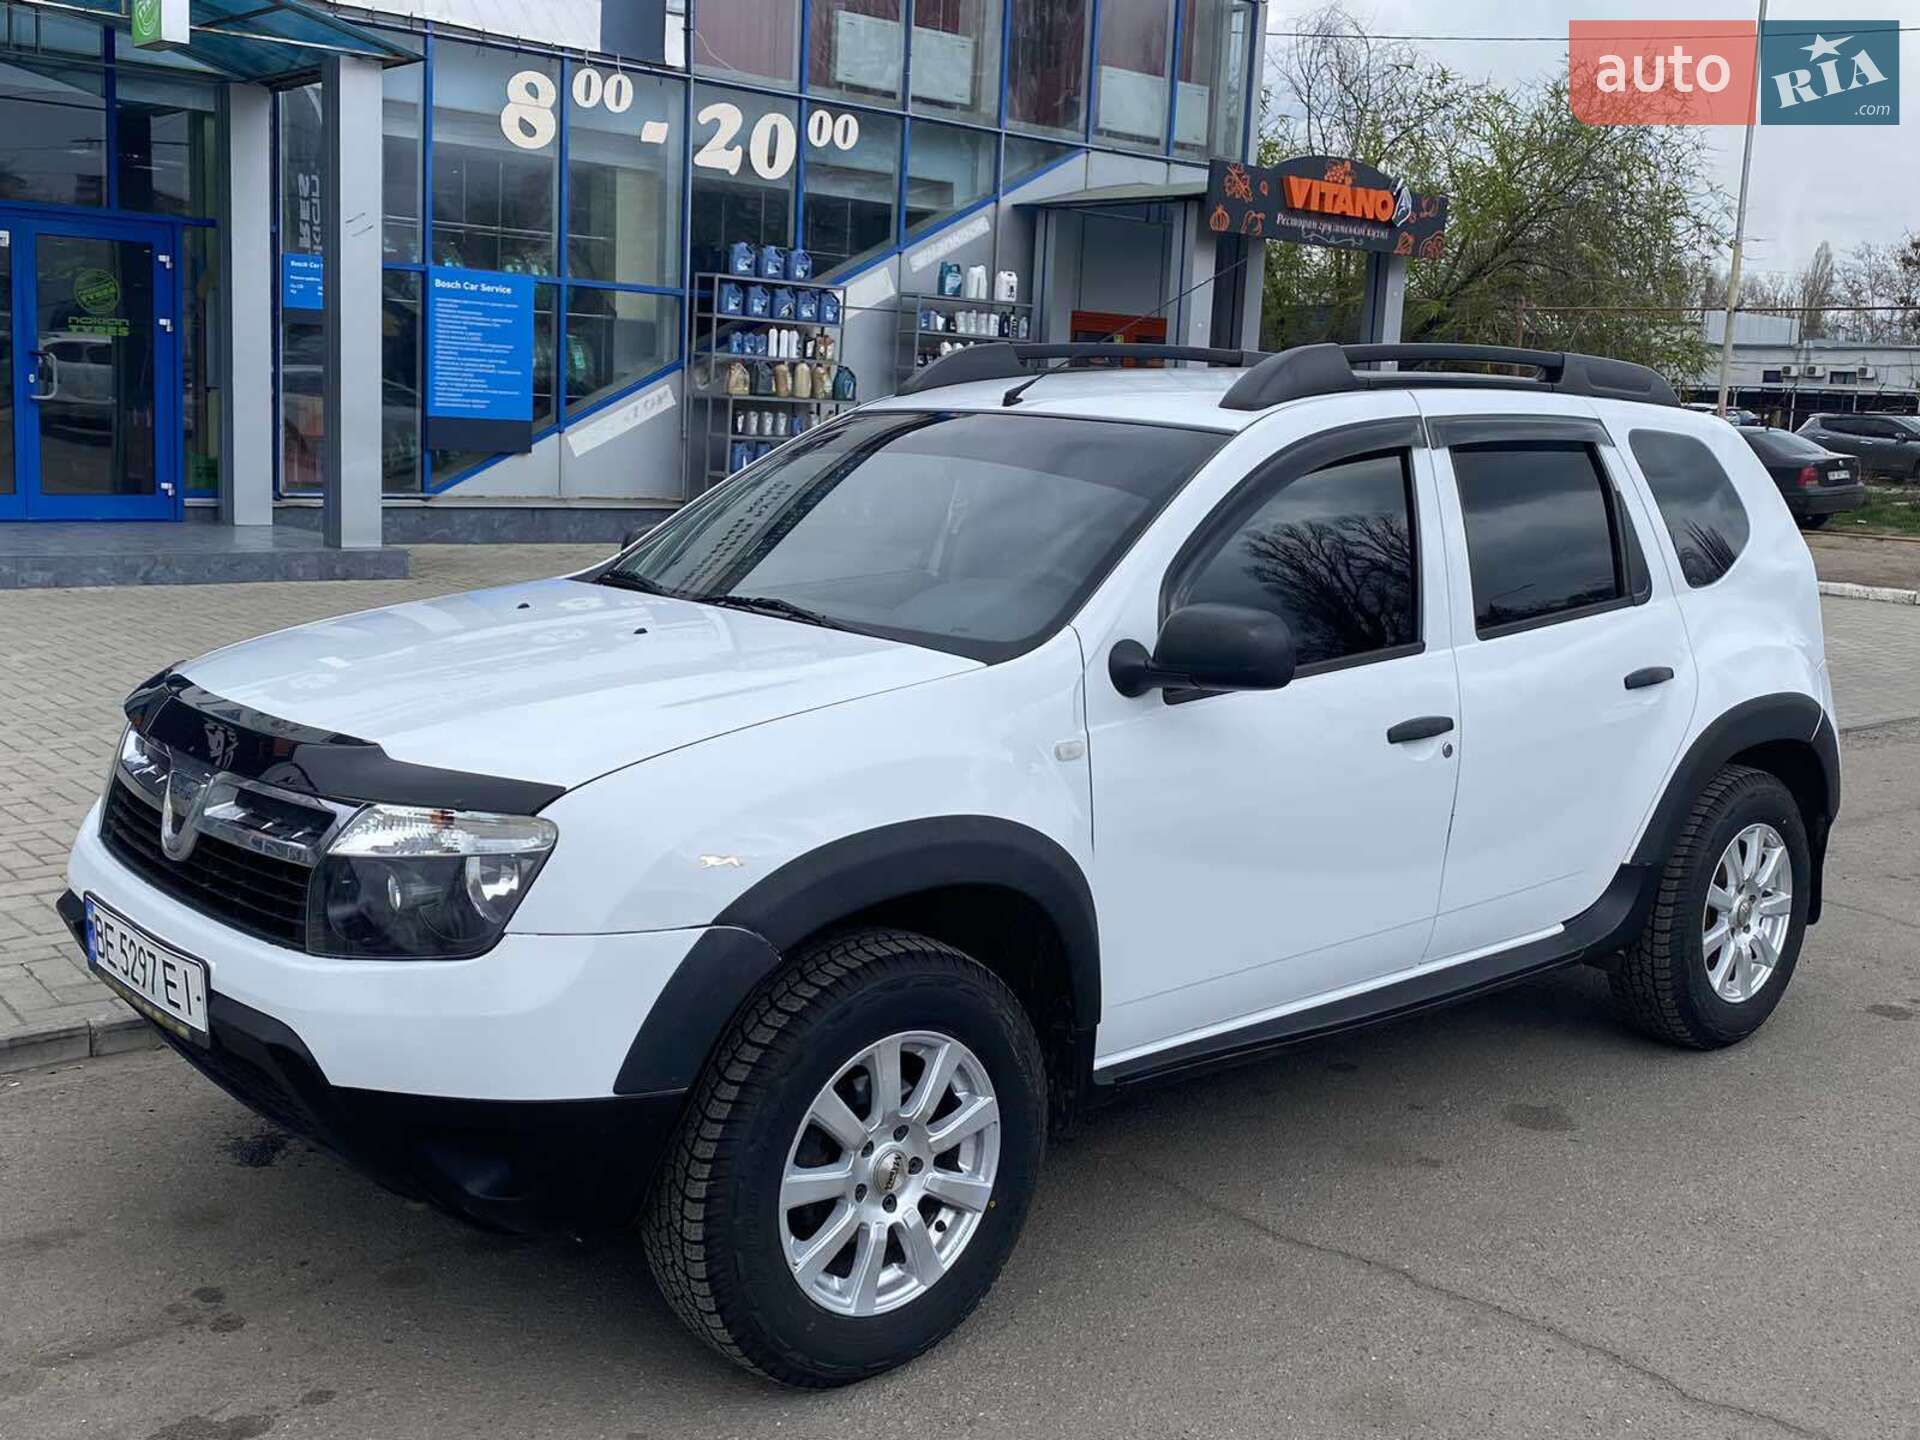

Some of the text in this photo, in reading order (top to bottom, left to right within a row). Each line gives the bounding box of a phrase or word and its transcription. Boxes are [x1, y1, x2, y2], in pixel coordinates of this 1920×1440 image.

[1283, 176, 1396, 222] VITANO
[434, 278, 512, 295] Bosch Car Service
[95, 914, 118, 970] BE
[120, 931, 156, 994] 5297
[162, 959, 193, 1016] EI
